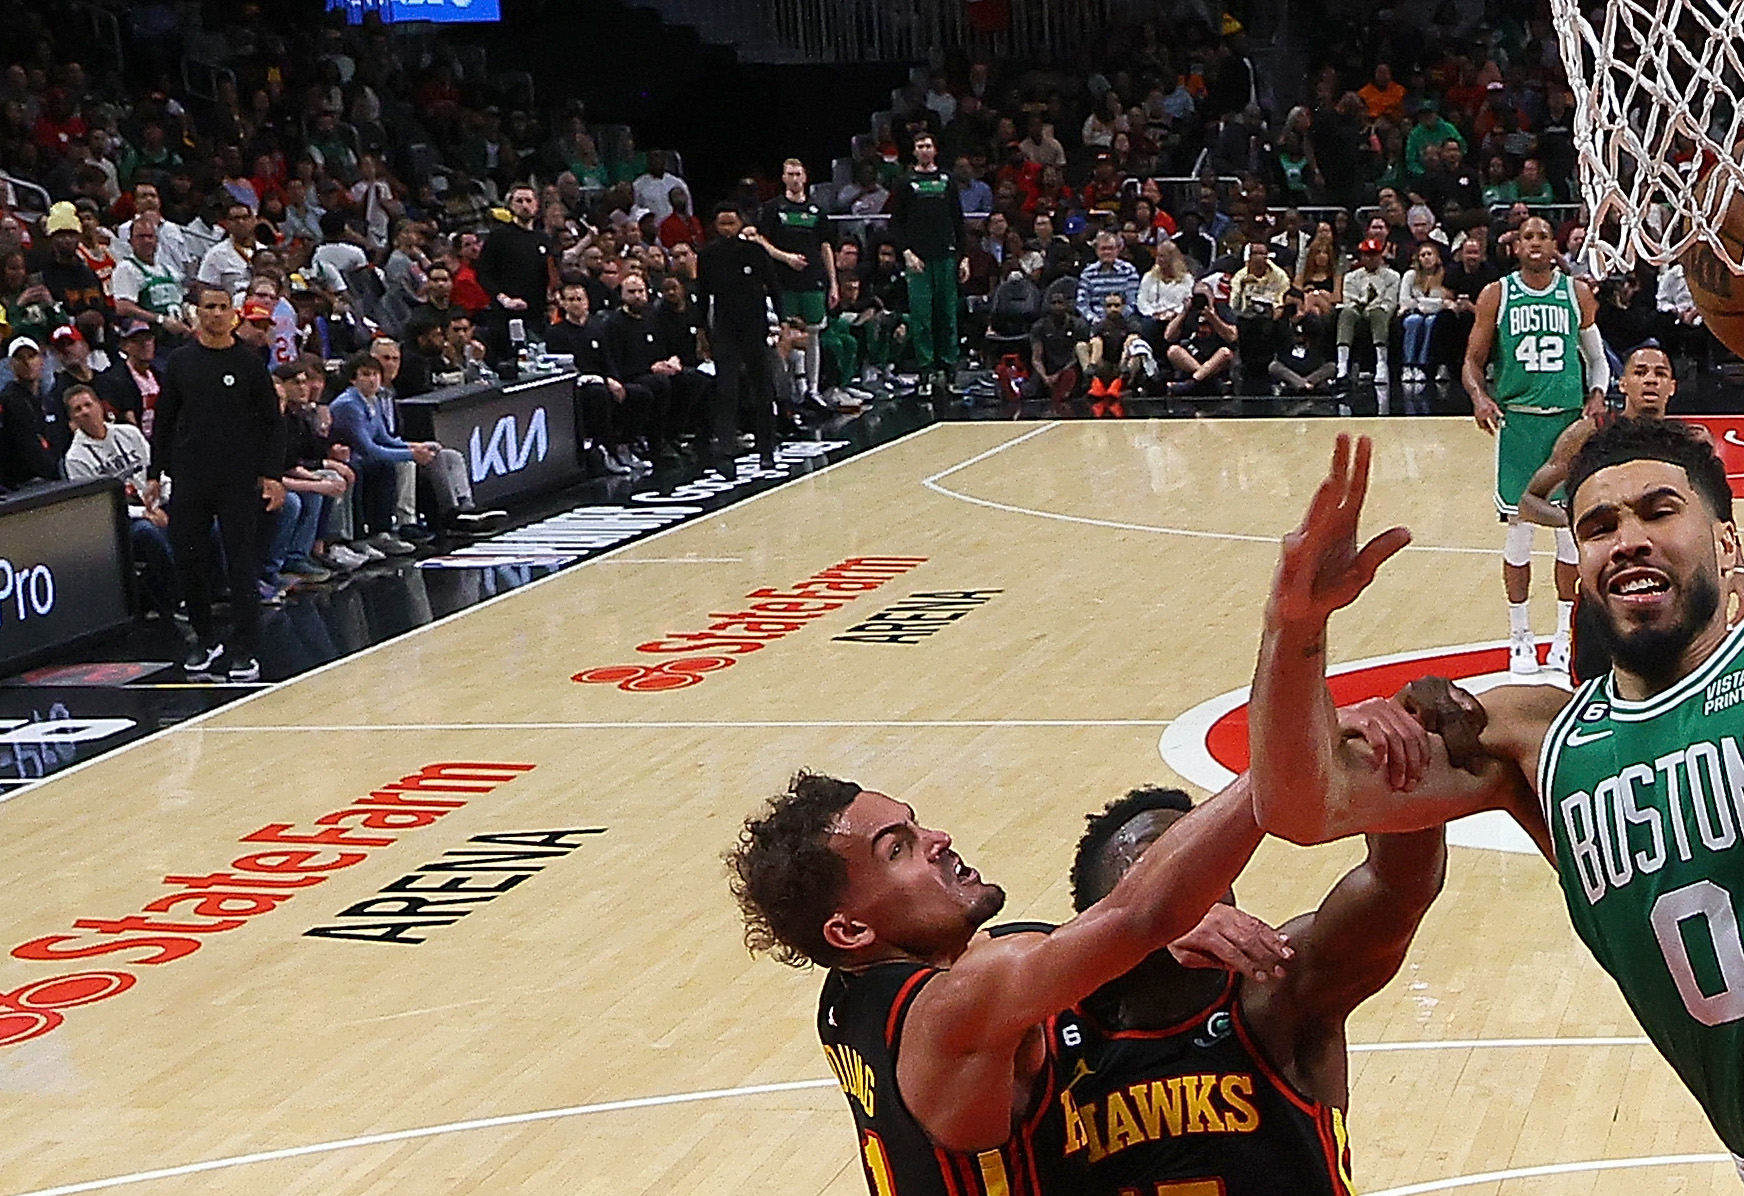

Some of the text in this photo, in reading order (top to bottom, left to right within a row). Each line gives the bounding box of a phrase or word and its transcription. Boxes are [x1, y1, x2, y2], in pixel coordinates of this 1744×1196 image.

[1509, 304, 1570, 337] BOSTON
[1514, 334, 1565, 372] 42
[469, 407, 548, 483] KIA
[830, 588, 1006, 645] ARENA
[1582, 703, 1609, 721] 6
[302, 826, 609, 945] ARENA
[1062, 1023, 1083, 1047] 6
[823, 1043, 875, 1118] OUNG
[1063, 1072, 1262, 1163] HAWKS
